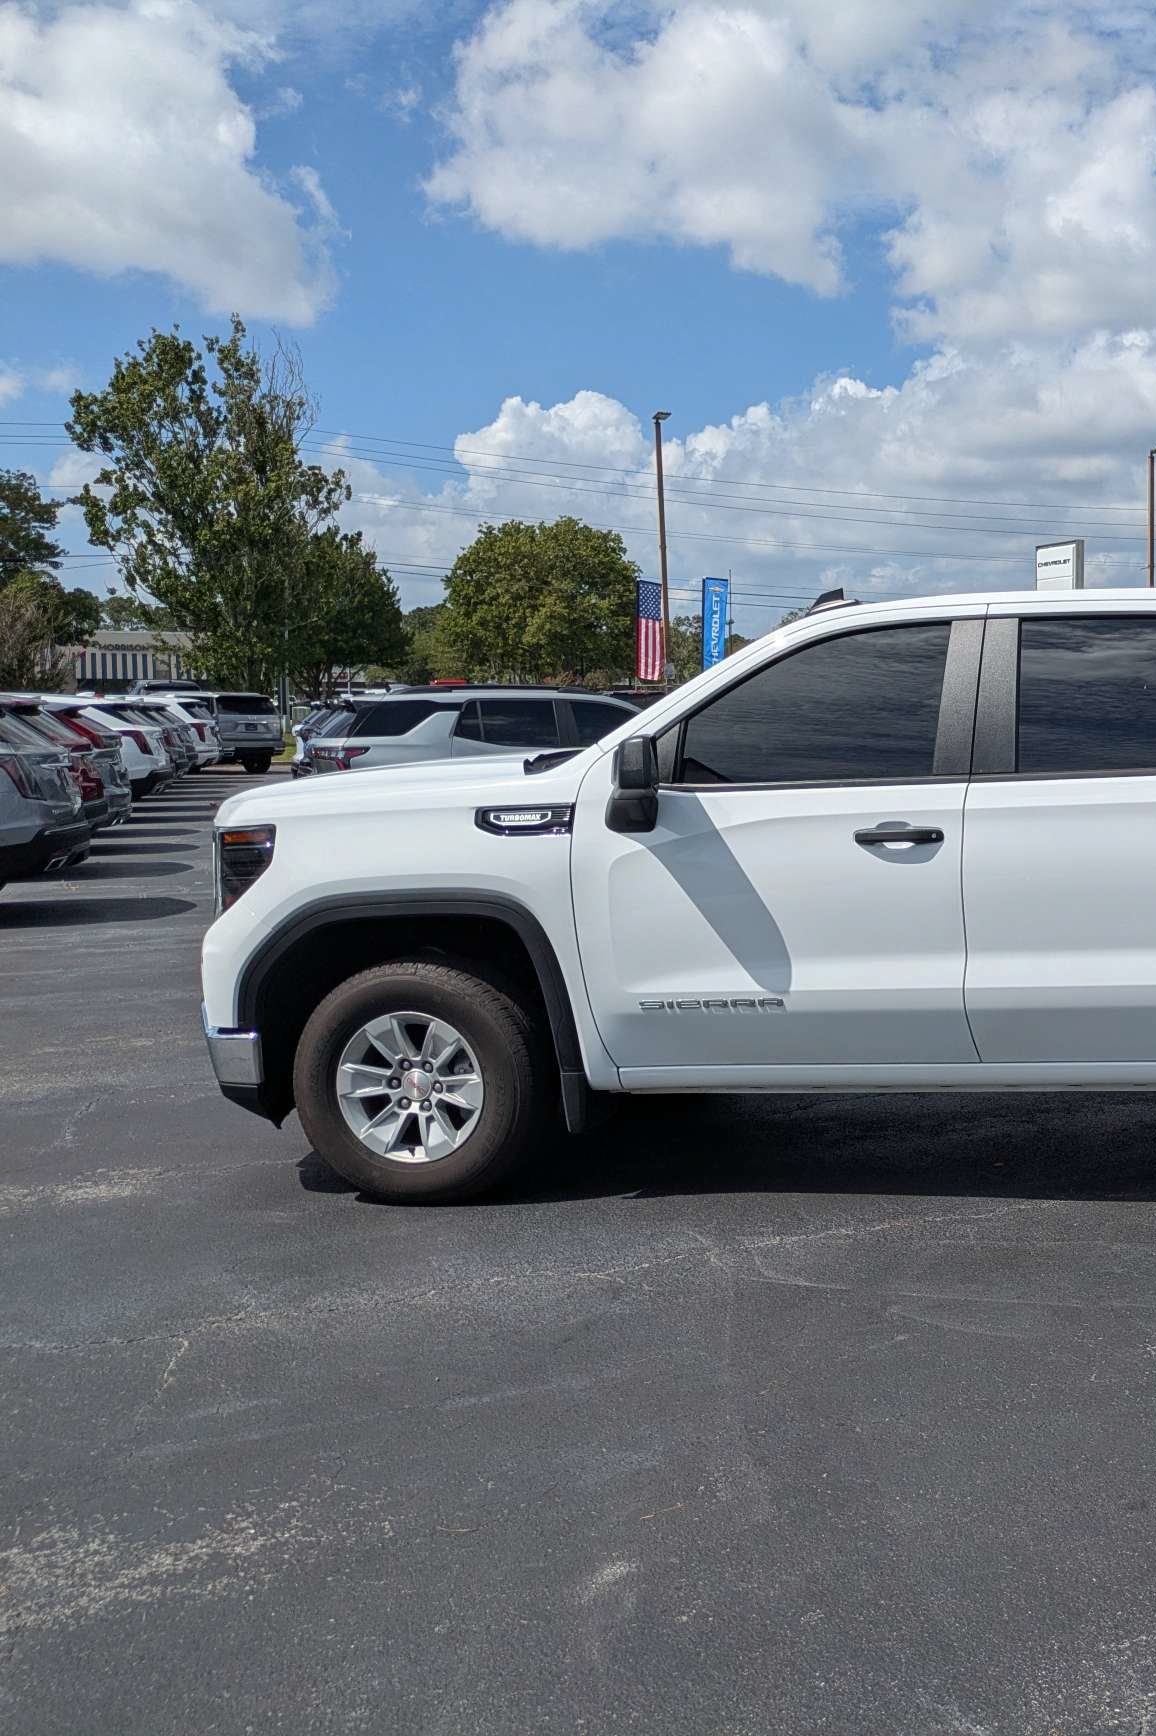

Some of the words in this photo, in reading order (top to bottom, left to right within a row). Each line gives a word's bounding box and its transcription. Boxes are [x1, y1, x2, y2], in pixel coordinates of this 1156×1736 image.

[1037, 558, 1071, 568] CHEVROLET
[710, 594, 720, 664] HEVROLET
[500, 813, 542, 823] TURBOMAX
[639, 998, 784, 1010] SIERRA
